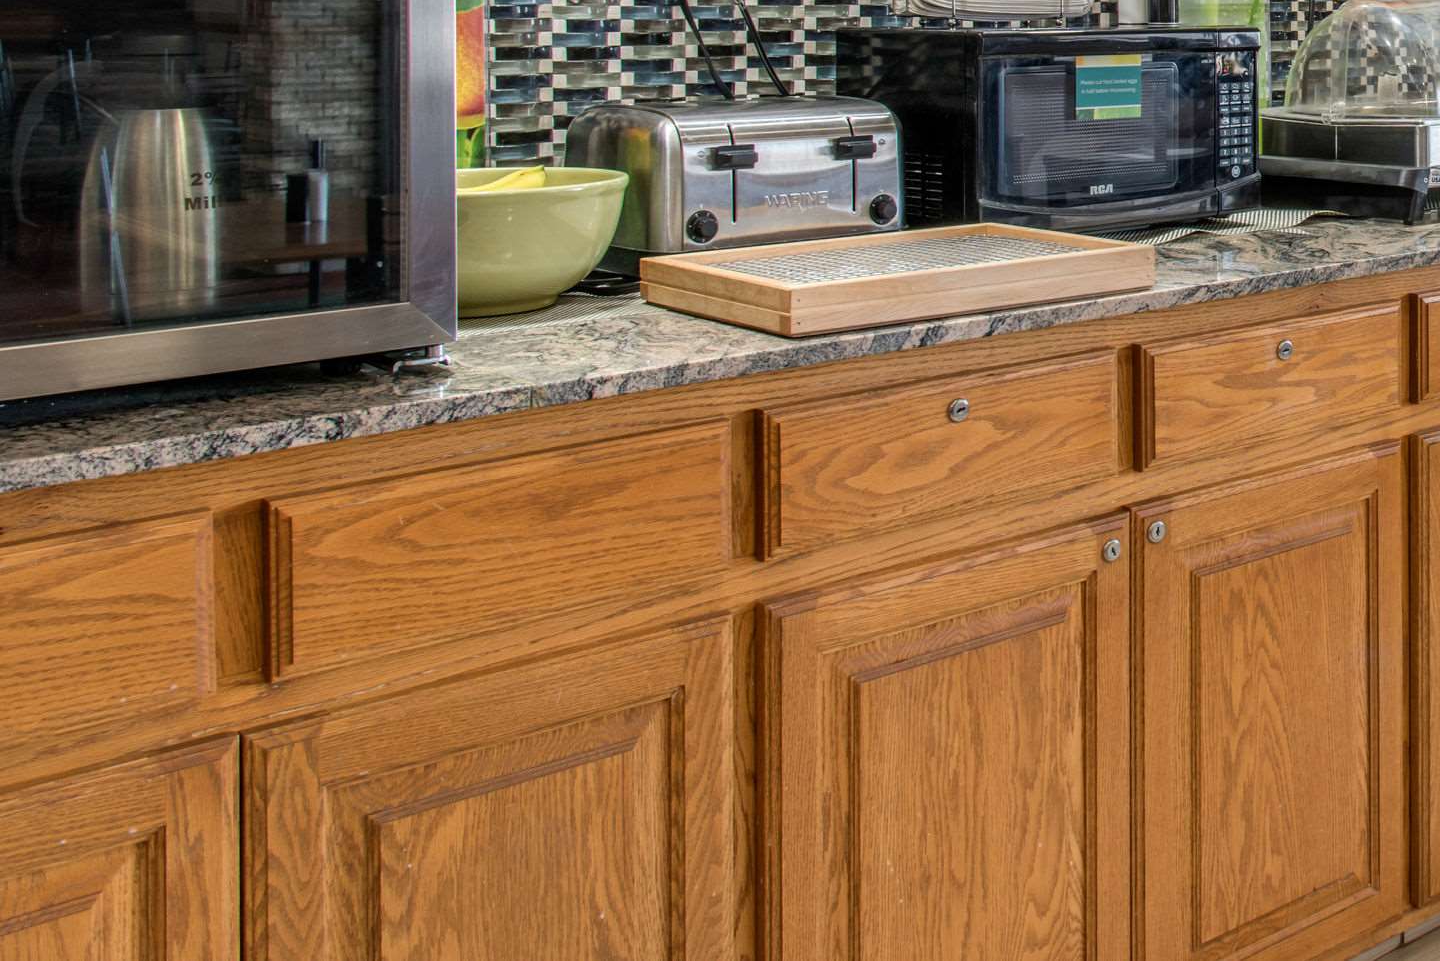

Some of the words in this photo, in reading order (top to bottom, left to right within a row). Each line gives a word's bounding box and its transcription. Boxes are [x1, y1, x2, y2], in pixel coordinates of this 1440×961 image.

[1090, 183, 1113, 195] RCA
[185, 196, 217, 211] Mil
[764, 190, 829, 208] WARING
